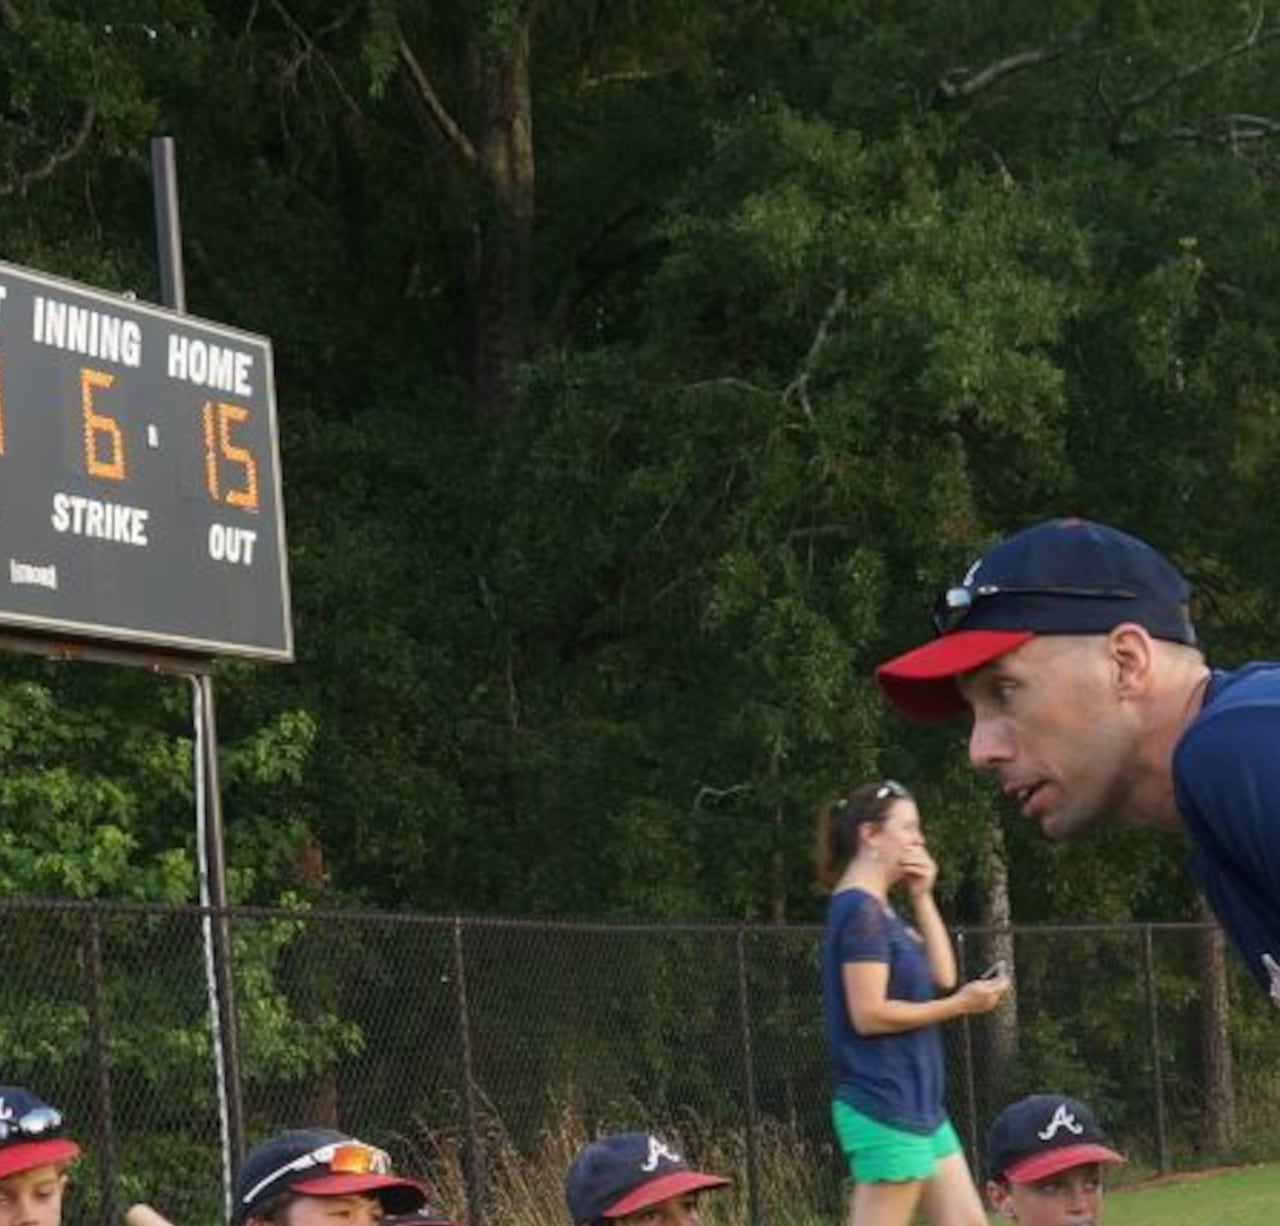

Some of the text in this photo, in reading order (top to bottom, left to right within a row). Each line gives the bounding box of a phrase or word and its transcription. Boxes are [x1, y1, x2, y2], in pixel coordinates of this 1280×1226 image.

[33, 297, 142, 368] INNING
[168, 334, 253, 397] HOME
[81, 367, 125, 480] 6
[203, 401, 259, 512] 15
[52, 493, 149, 546] STRIKE
[209, 524, 257, 566] OUT
[640, 1135, 681, 1171] A
[1038, 1103, 1084, 1140] A
